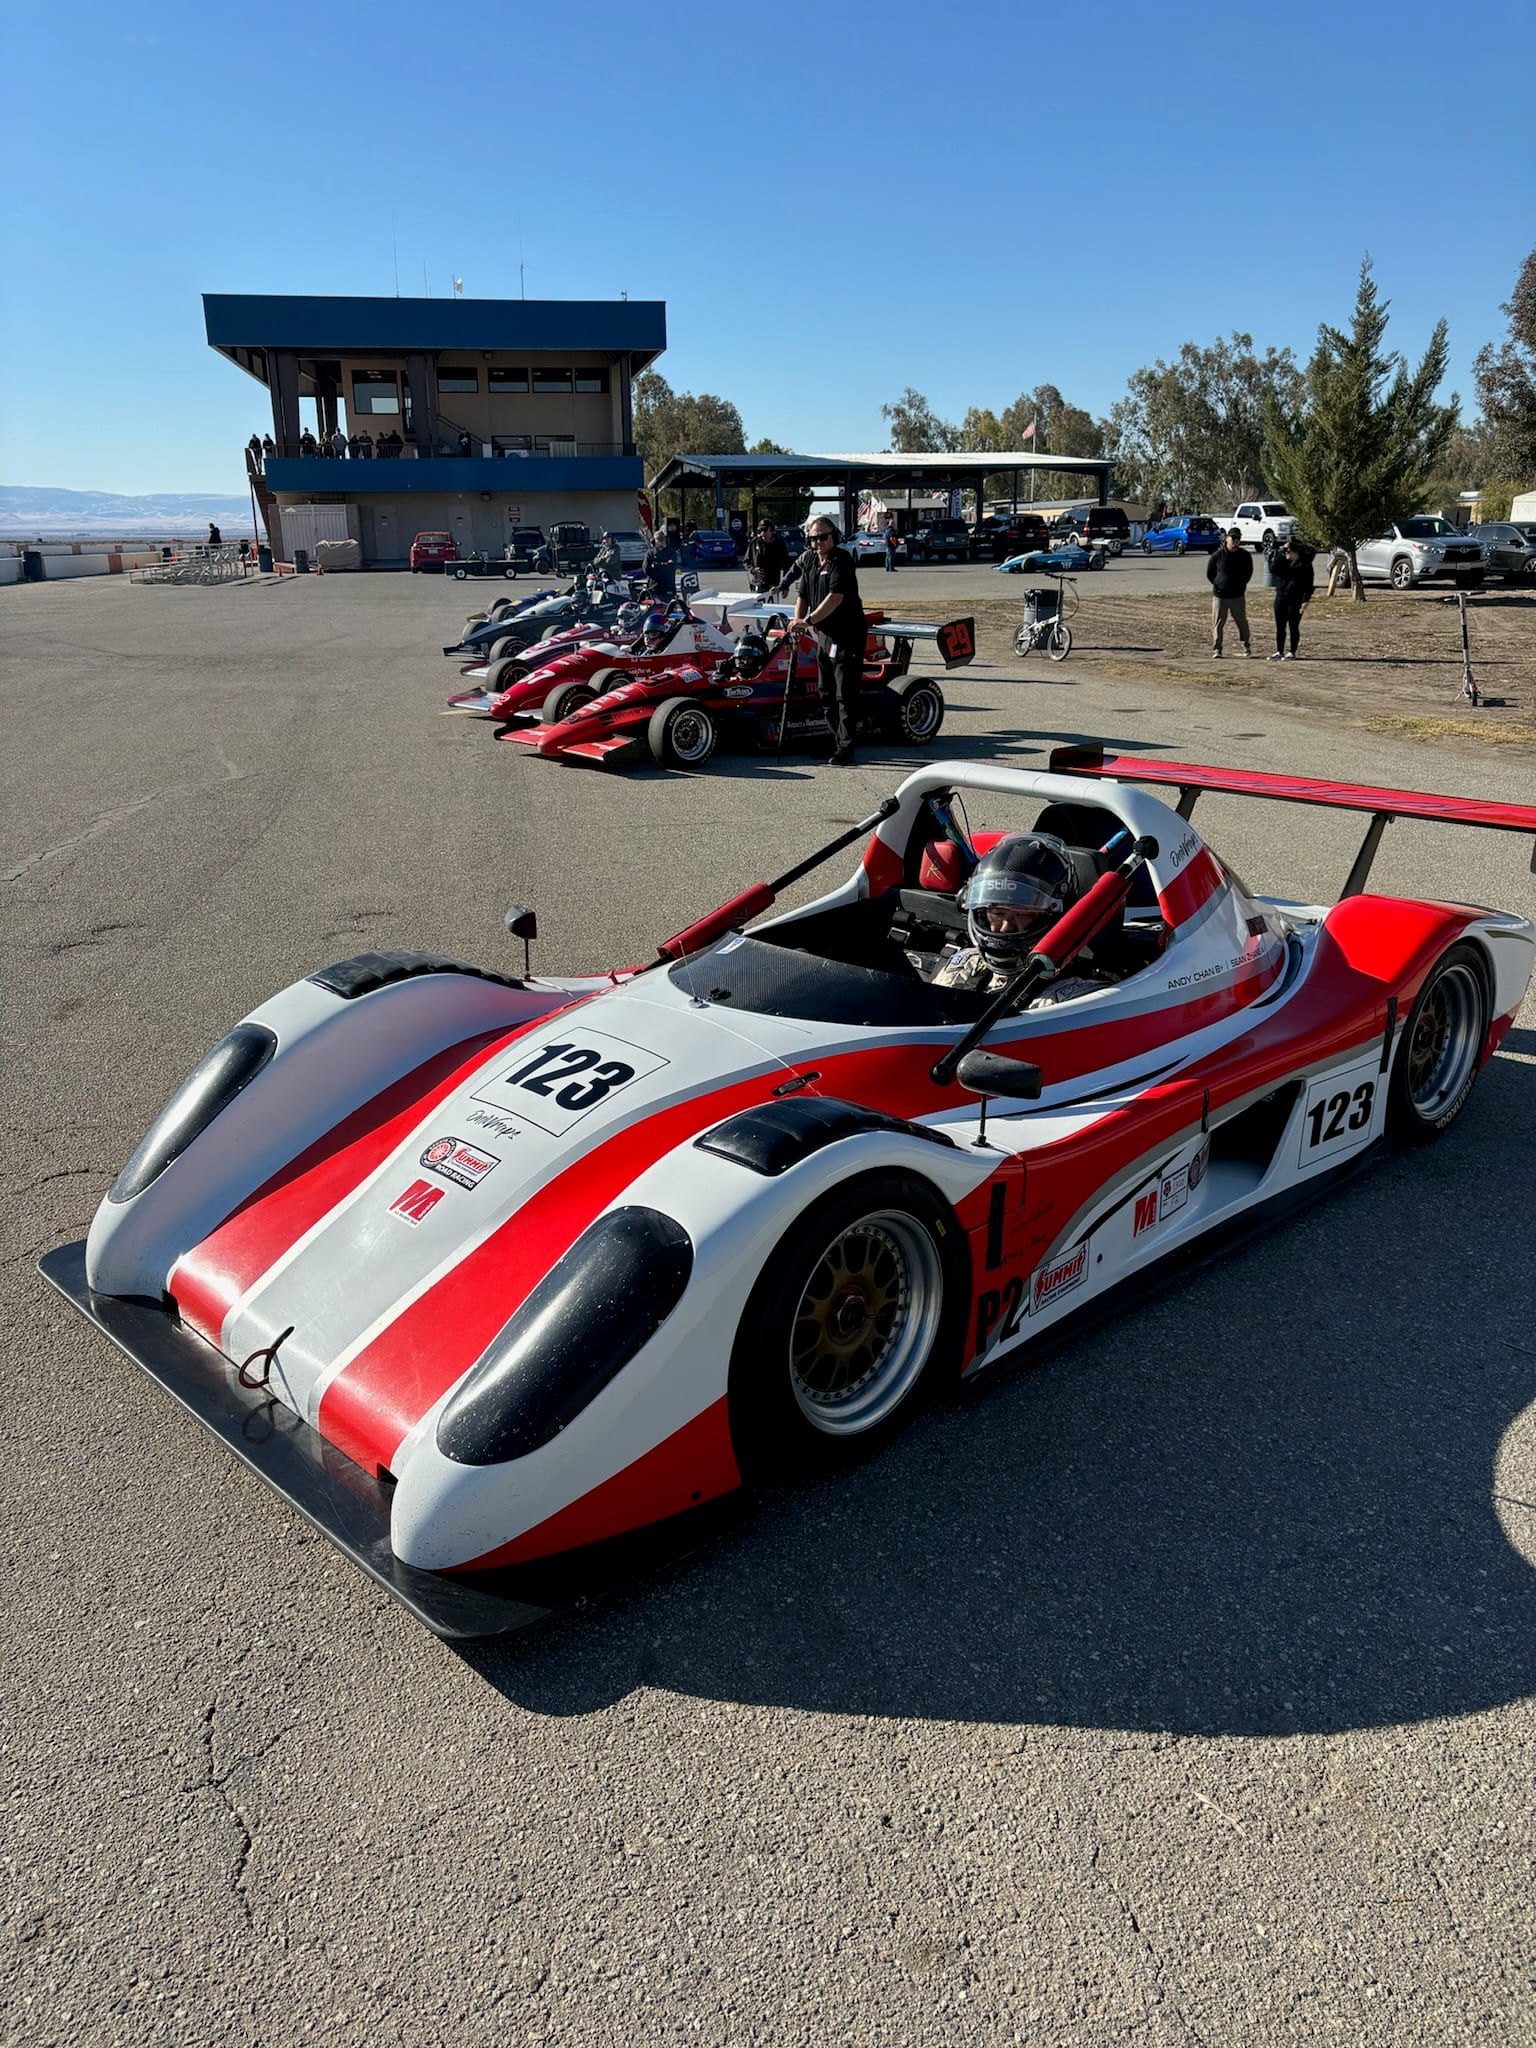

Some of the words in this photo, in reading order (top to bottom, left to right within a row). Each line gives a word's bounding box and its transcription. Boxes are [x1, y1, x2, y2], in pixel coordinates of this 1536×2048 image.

[943, 623, 972, 658] 29
[987, 877, 1017, 891] stilo
[1168, 975, 1192, 990] ANDY
[1193, 968, 1216, 983] CHAN
[505, 1043, 635, 1111] 123
[1307, 1081, 1375, 1148] 123
[1435, 1079, 1473, 1129] HANKOOK
[436, 1164, 453, 1176] ROAD
[450, 1171, 475, 1189] RACING
[453, 1147, 489, 1173] SUMMIT
[1035, 1251, 1085, 1302] SUMMIT
[975, 1276, 1024, 1358] P2
